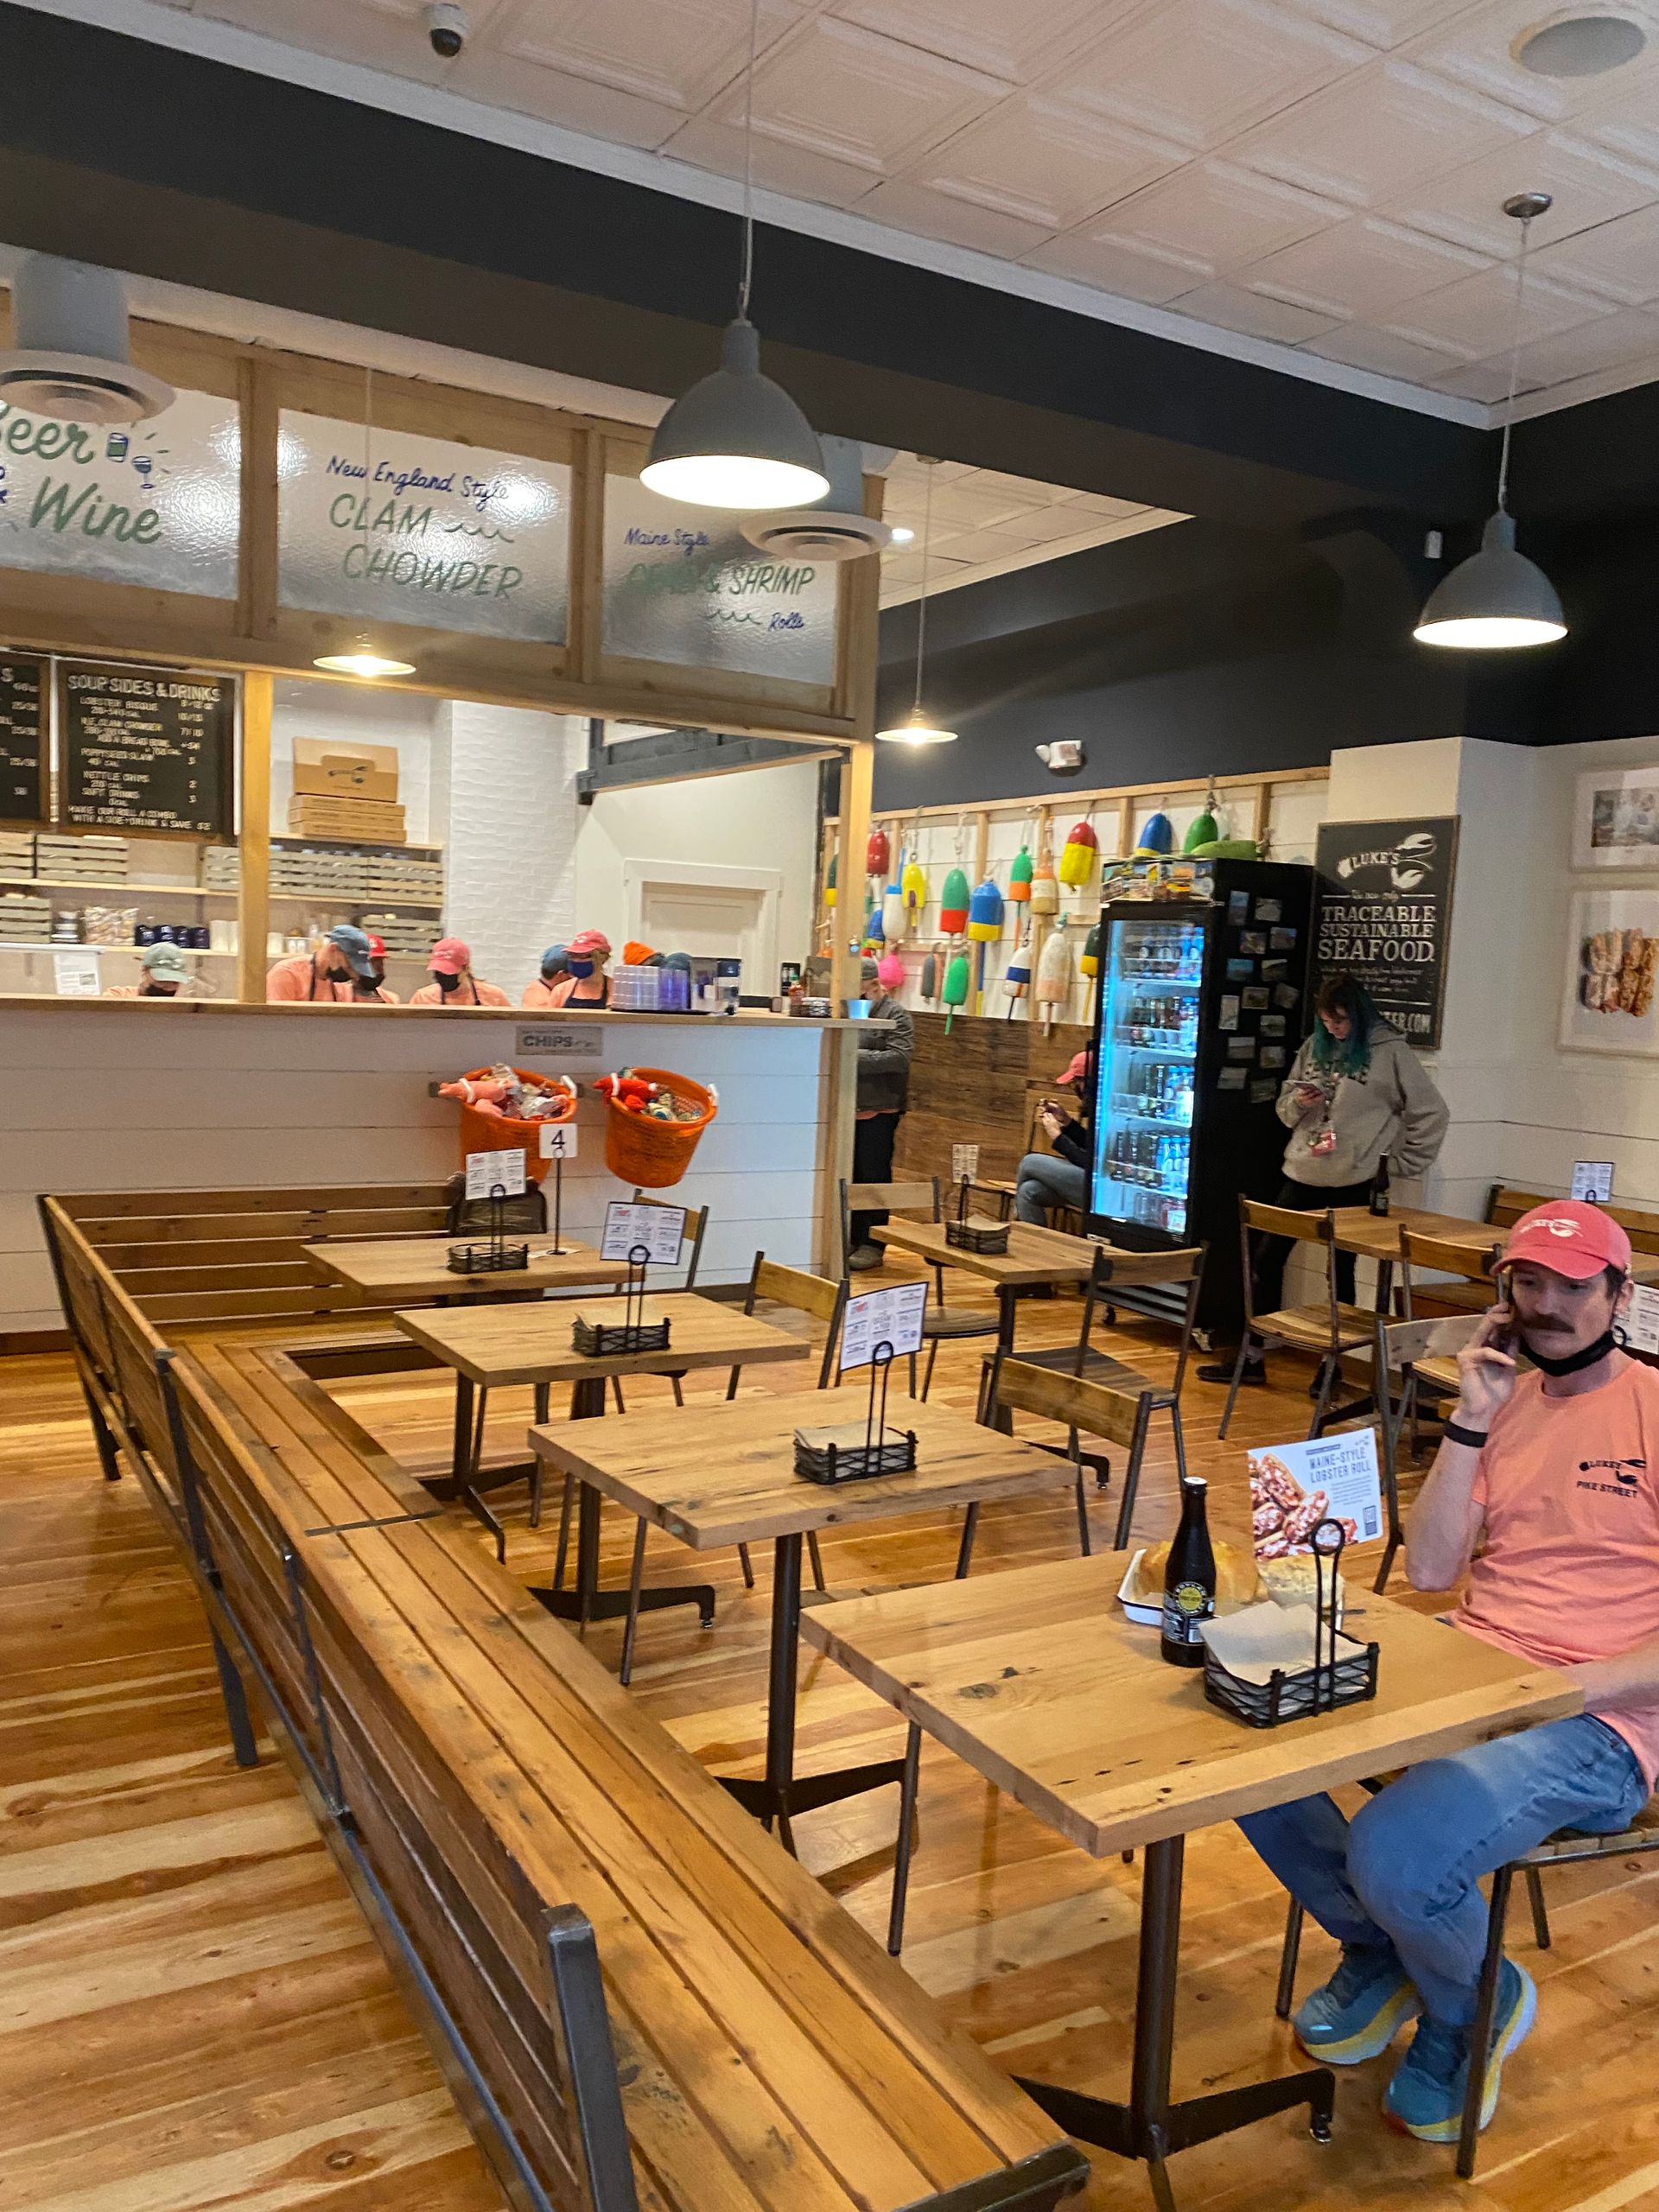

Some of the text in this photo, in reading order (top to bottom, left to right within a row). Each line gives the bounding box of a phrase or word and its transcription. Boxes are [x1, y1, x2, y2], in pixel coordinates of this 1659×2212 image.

[325, 454, 367, 477] New
[29, 476, 162, 544] Wine
[329, 493, 433, 536] CLAM
[624, 528, 710, 556] Maine Style
[344, 543, 523, 599] CHOWDER
[729, 563, 816, 595] SHRIMP
[109, 677, 154, 696] SIDES
[168, 683, 221, 702] DRINKS
[1351, 851, 1401, 869] LUKE'S
[1321, 906, 1437, 922] TRACEABLE
[1319, 923, 1434, 938] SUSTAINABLE
[524, 1035, 573, 1047] CHIPS
[551, 1129, 566, 1148] 4
[1309, 1447, 1367, 1470] MAINE-STYLE
[1310, 1460, 1371, 1484] LOBSTER ROLL
[1577, 1480, 1637, 1498] PIKE STREET
